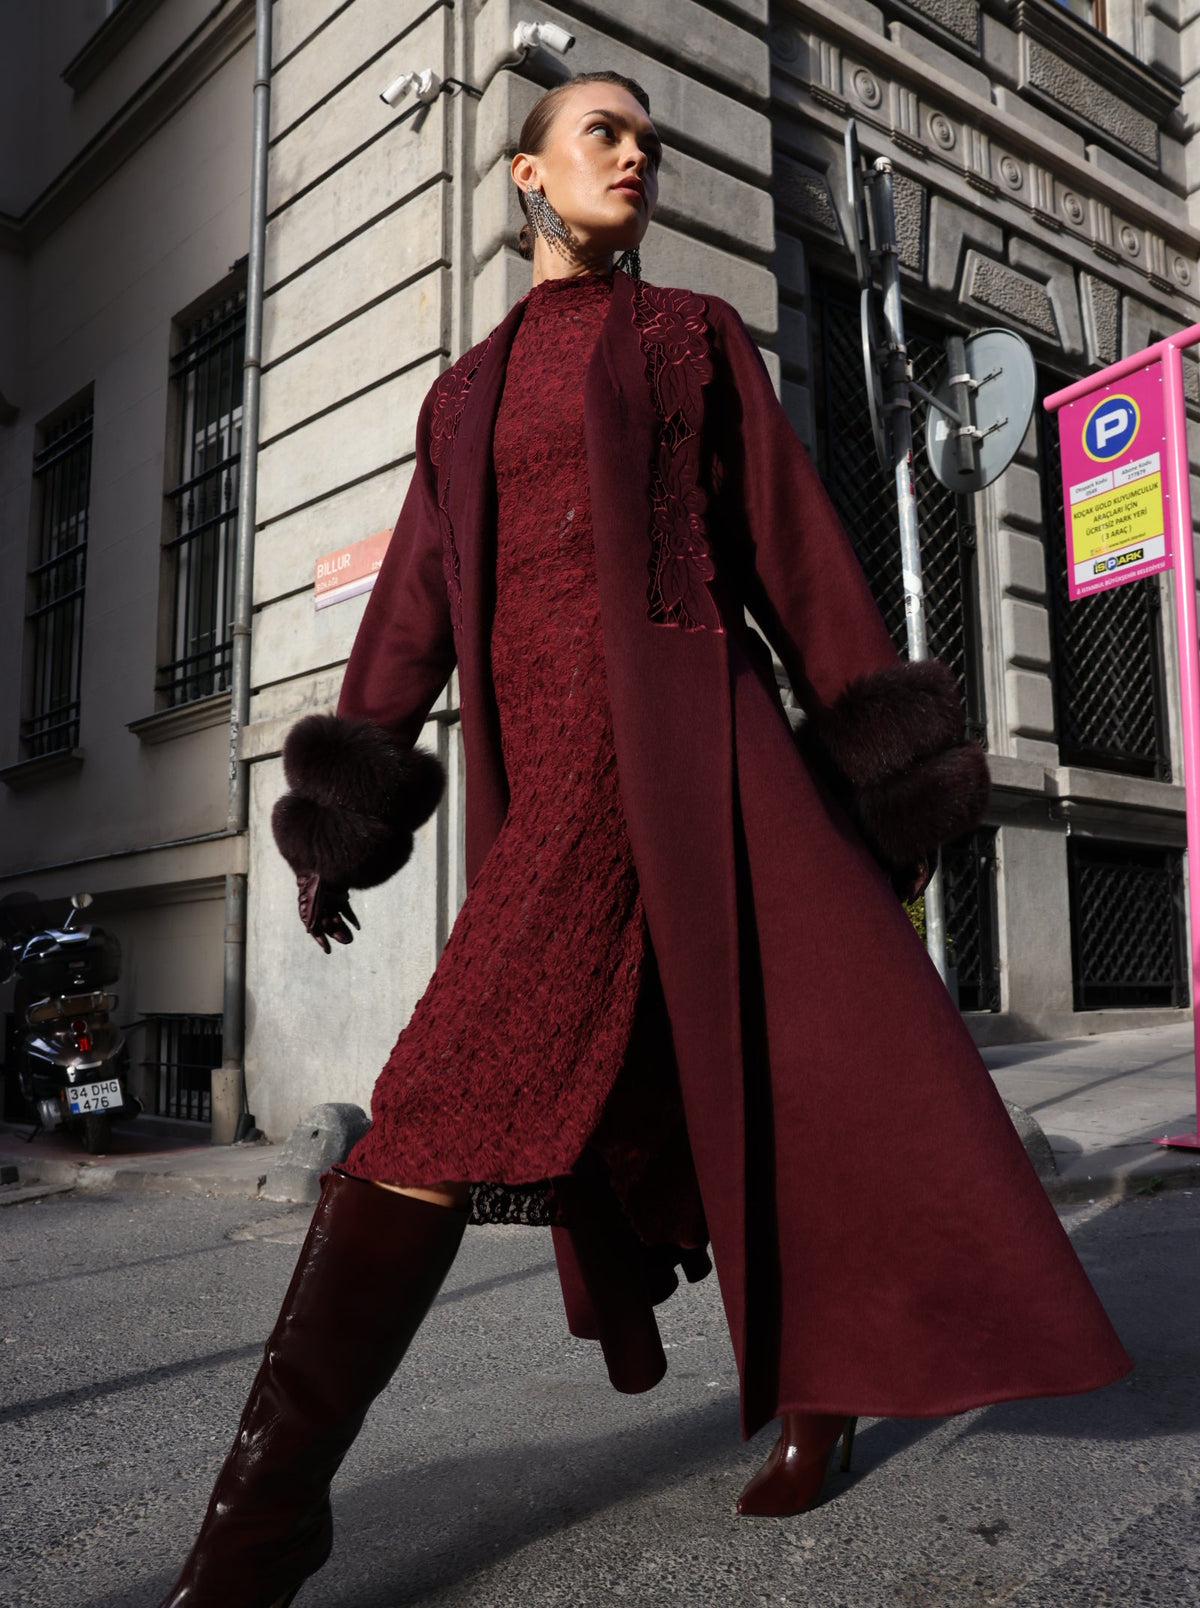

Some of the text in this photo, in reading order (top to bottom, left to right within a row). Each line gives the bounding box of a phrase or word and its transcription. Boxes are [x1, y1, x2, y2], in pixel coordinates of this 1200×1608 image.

[1095, 408, 1128, 450] P
[1073, 482, 1159, 519] KOÇAK GOLD KUYUMCULUK
[1085, 507, 1148, 536] ÜCRETSİZ PARK YERİ
[1093, 501, 1138, 523] ARAÇLARI İÇİN
[1111, 526, 1128, 538] ARAÇ
[70, 1081, 118, 1100] 34 DHG
[83, 1096, 110, 1110] 476
